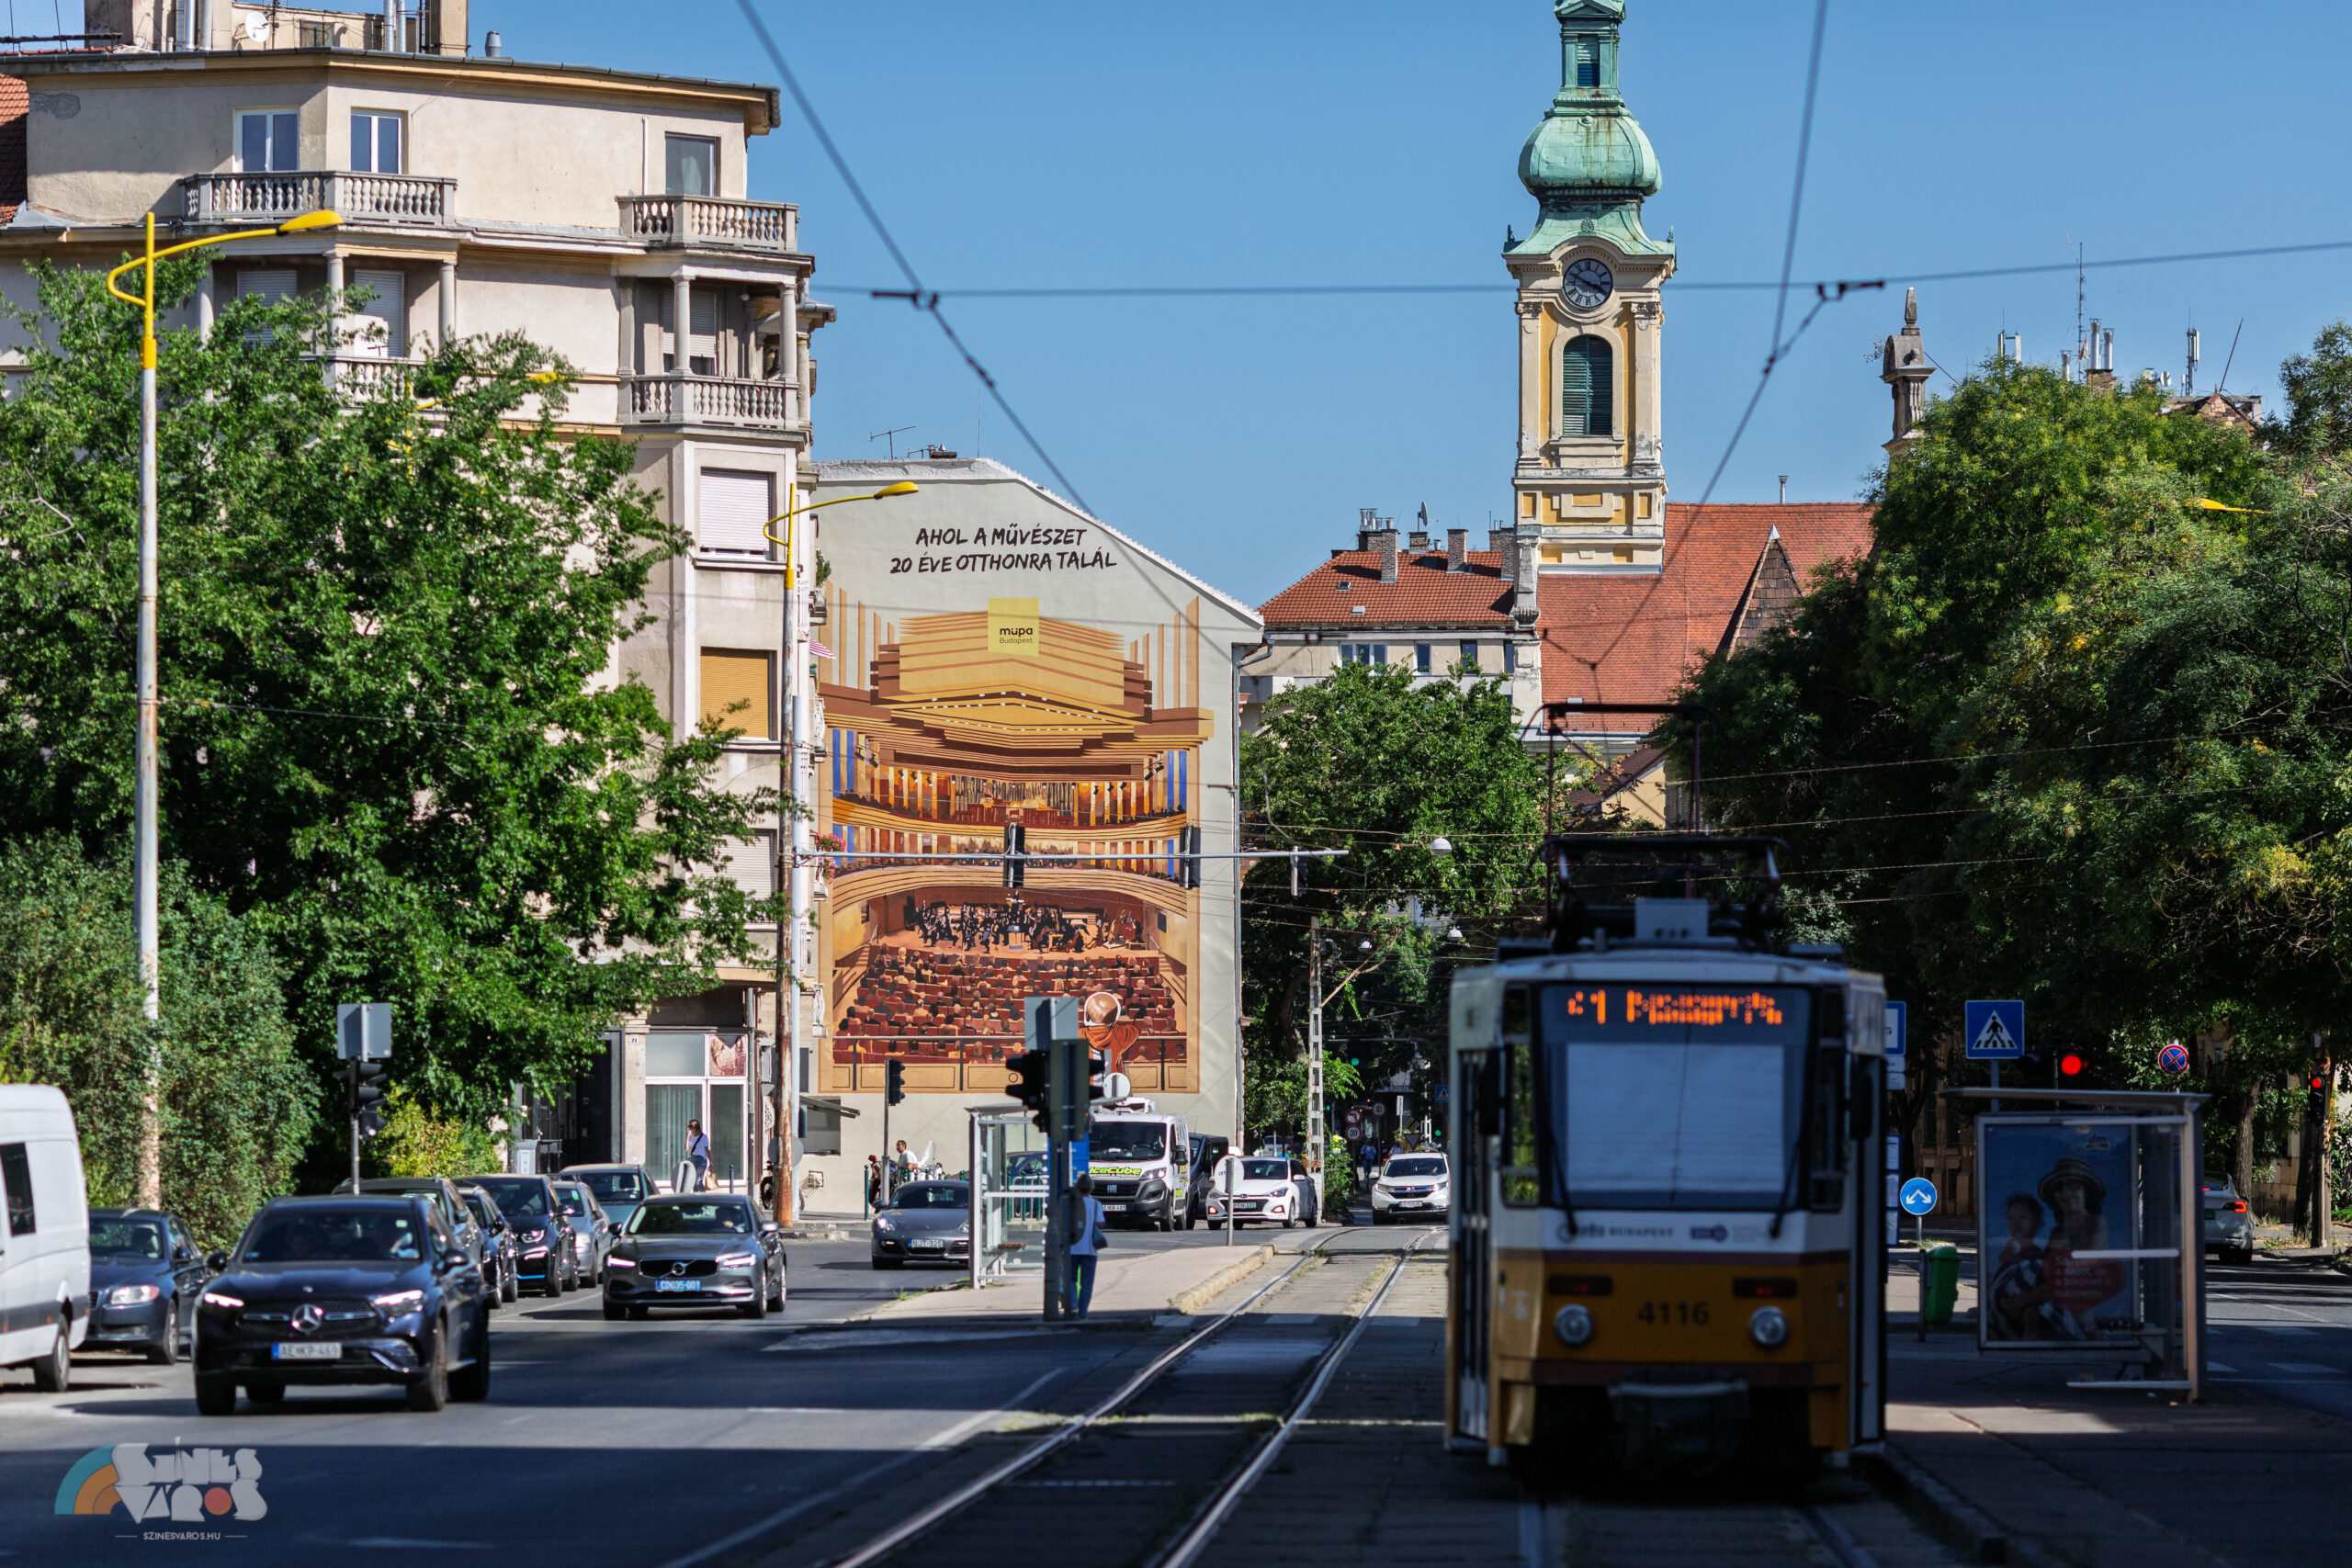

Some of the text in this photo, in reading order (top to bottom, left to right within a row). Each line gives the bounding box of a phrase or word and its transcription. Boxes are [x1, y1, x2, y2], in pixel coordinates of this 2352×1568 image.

[915, 523, 1088, 547] AHOL A MŰVÉSZET
[889, 546, 1118, 574] 20 ÉVE OTTHONRA TALÁL
[999, 637, 1034, 645] Budapest
[1089, 1167, 1142, 1175] IceCube
[1638, 1301, 1710, 1325] 4116
